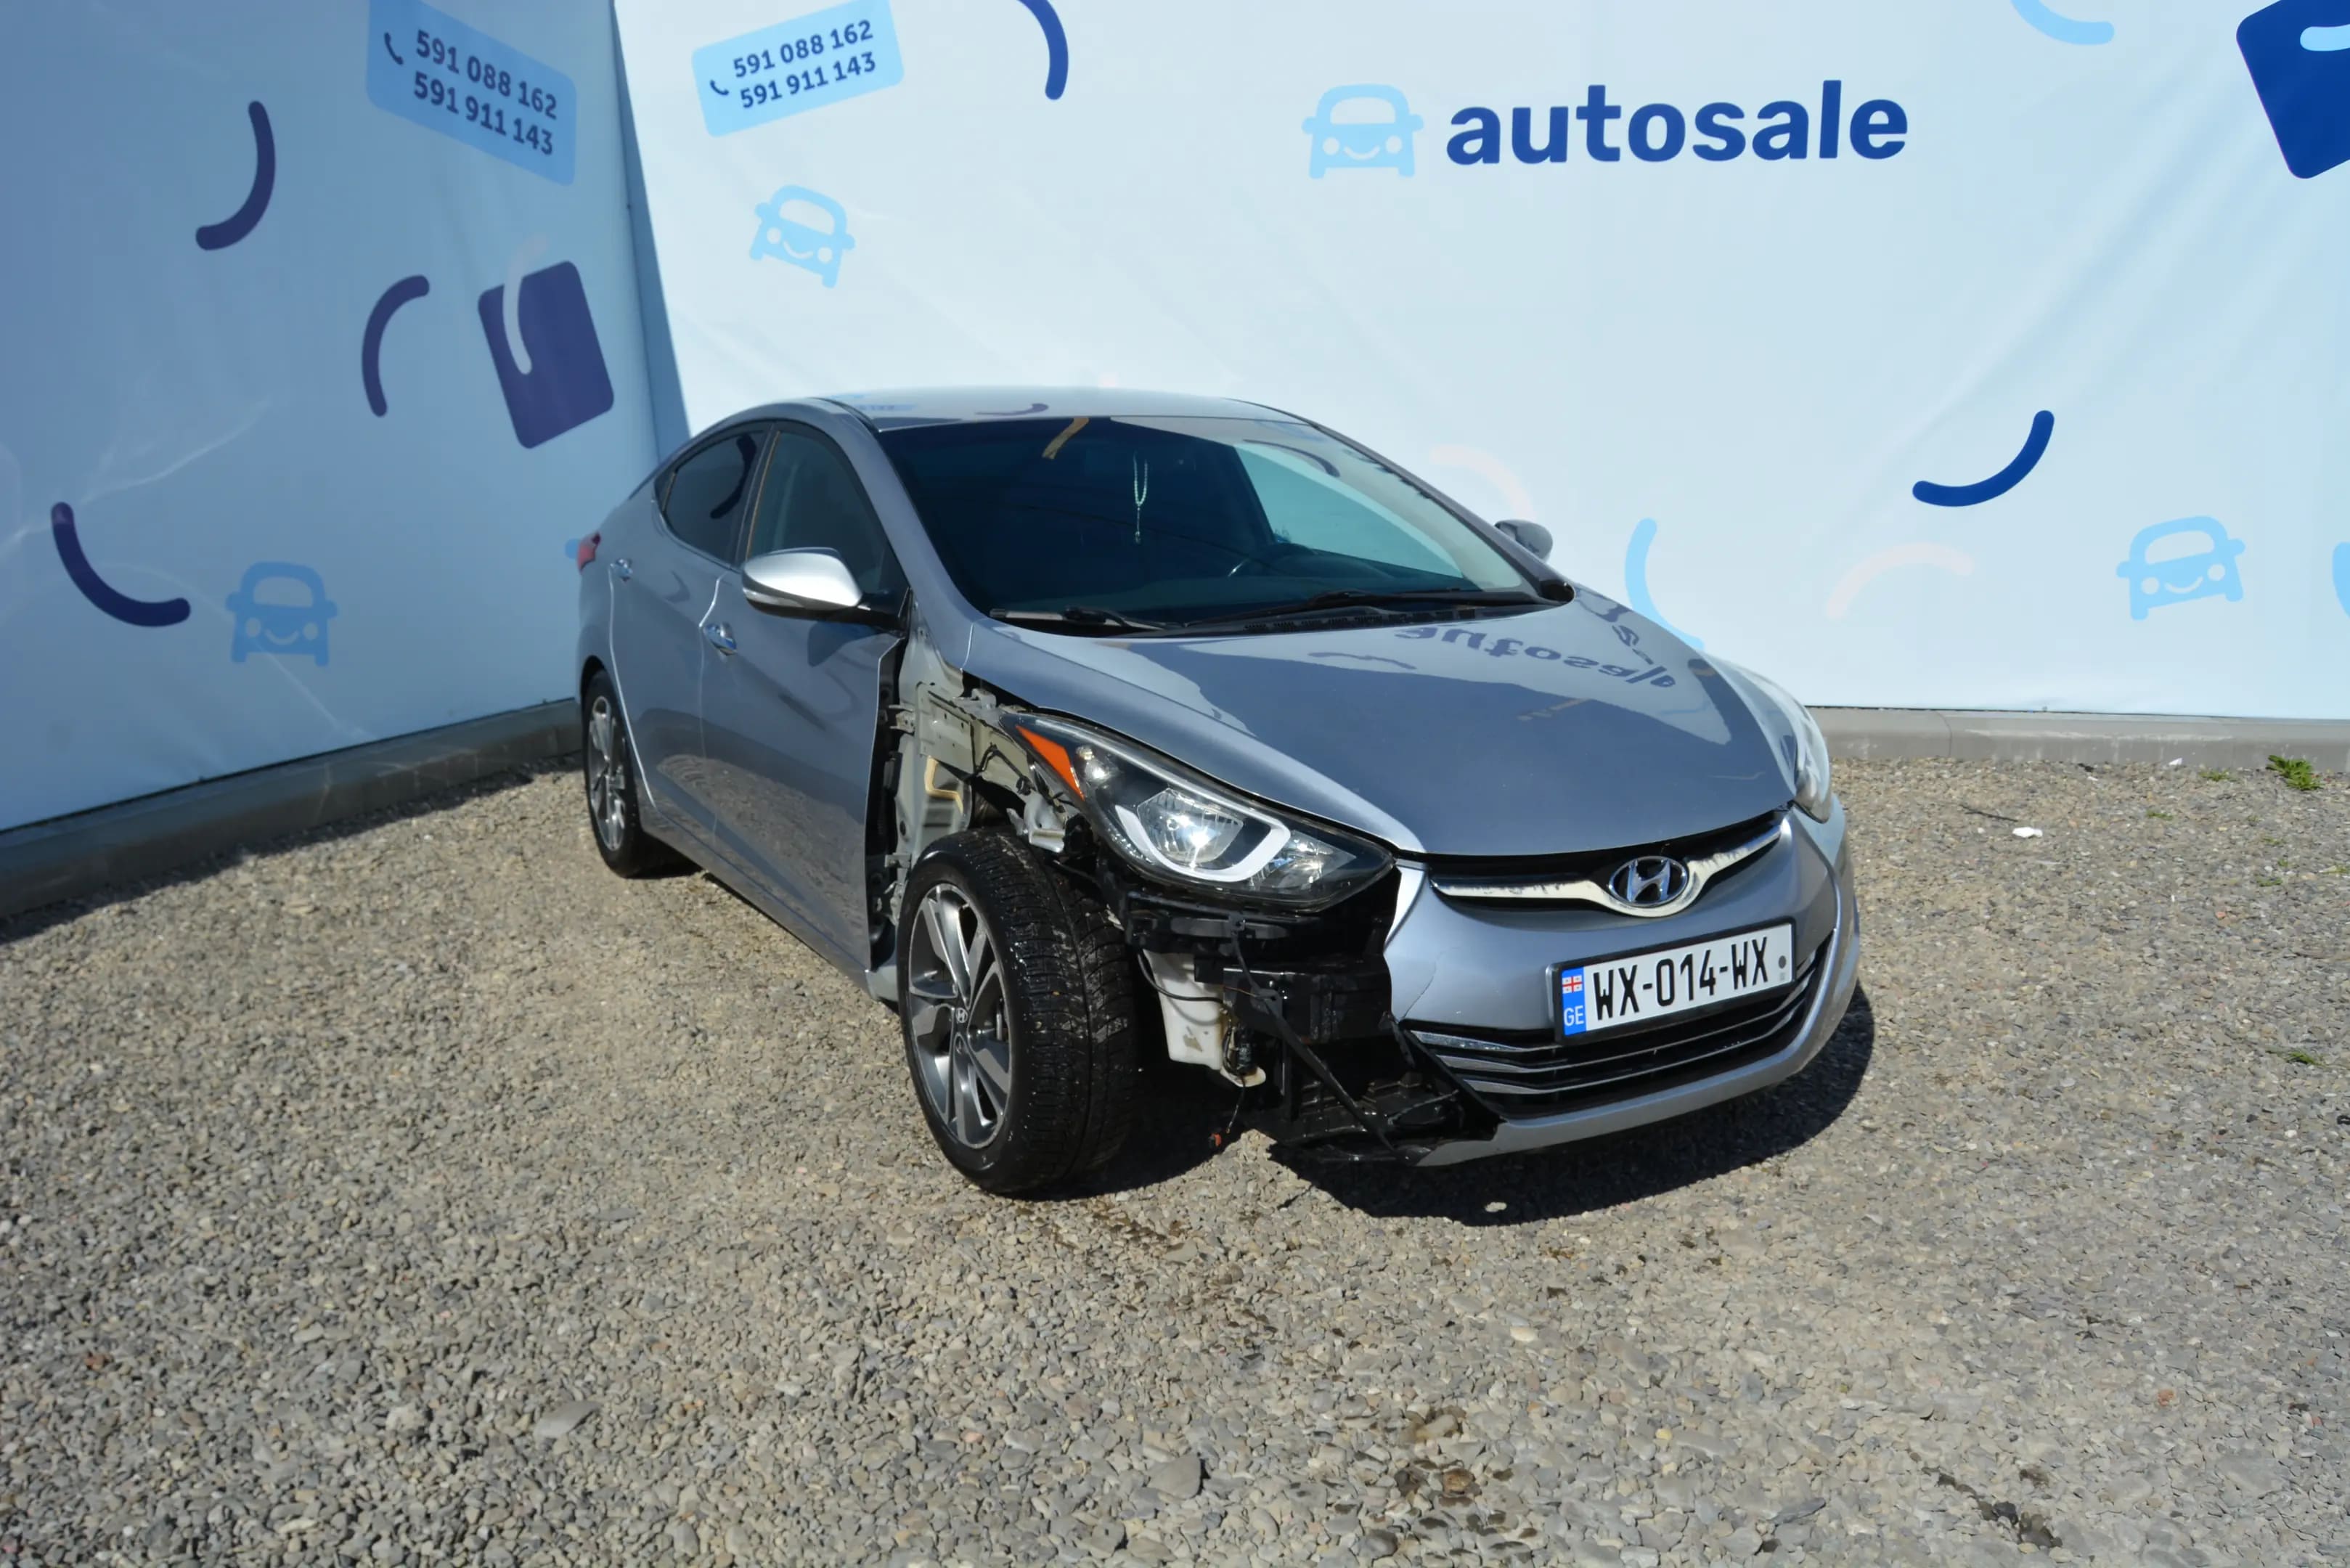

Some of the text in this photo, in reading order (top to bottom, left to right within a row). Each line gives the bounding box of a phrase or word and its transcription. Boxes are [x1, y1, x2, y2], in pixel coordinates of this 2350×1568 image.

[415, 29, 557, 120] 591 088 162
[733, 20, 873, 78] 591 088 162
[740, 52, 876, 108] 591 911 143
[414, 70, 552, 155] 591 911 143
[1446, 79, 1909, 165] autosale
[1564, 1005, 1585, 1026] GE
[1593, 936, 1768, 1021] WX-014-WX
